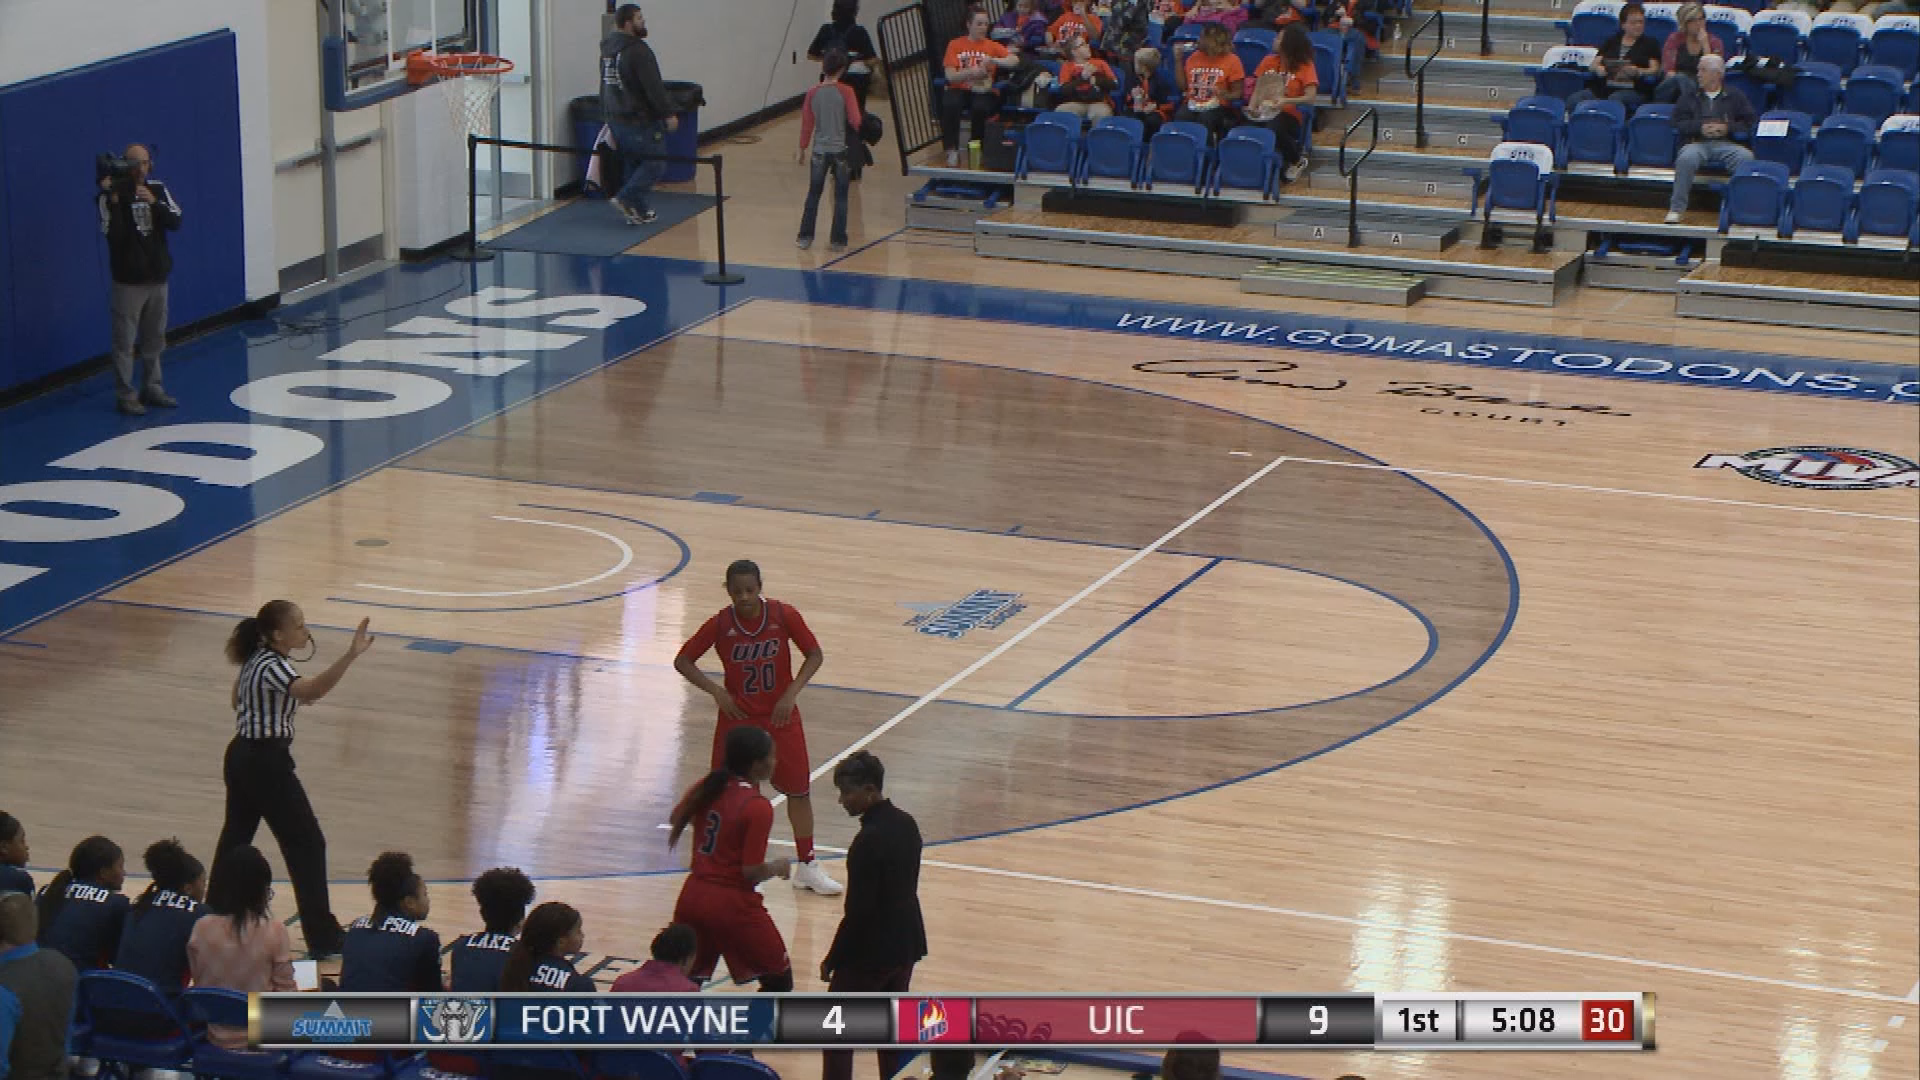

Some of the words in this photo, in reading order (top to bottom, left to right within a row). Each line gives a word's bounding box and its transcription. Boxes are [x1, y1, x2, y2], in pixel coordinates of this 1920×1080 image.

[0, 286, 646, 591] ODONS
[731, 638, 780, 662] UIC
[742, 662, 776, 693] 20
[700, 811, 721, 855] 3
[64, 882, 110, 903] FORD
[152, 889, 198, 912] PLEY
[529, 964, 571, 989] SON
